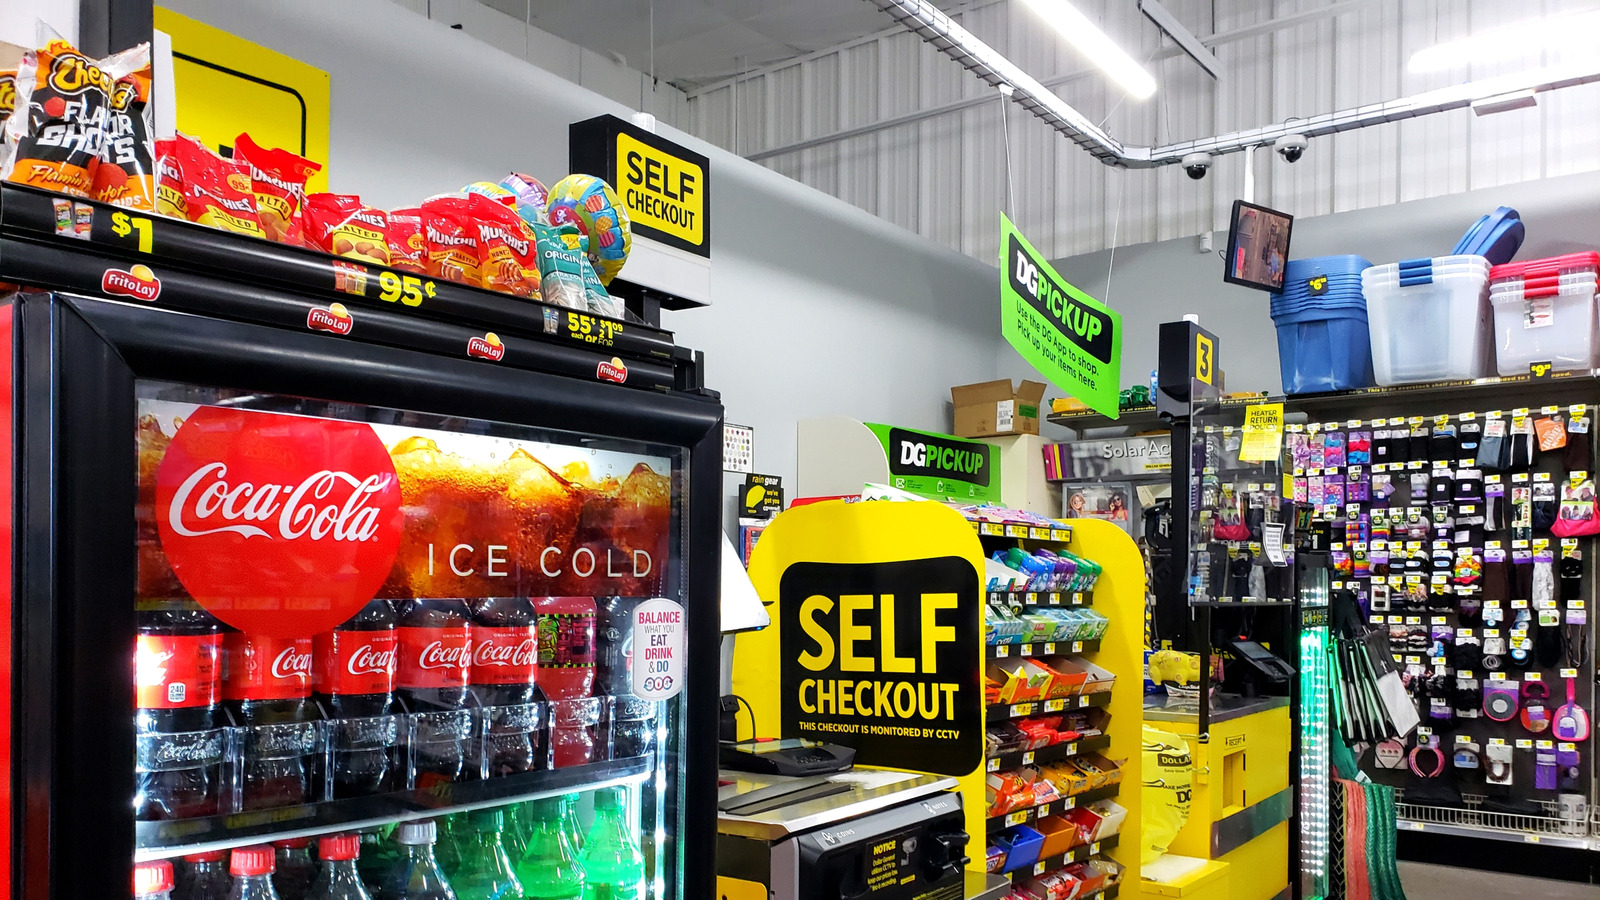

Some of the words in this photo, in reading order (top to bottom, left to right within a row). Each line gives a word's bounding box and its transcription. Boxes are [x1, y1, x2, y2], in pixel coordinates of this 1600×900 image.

[626, 151, 695, 203] SELF
[258, 196, 289, 214] ALTED
[626, 188, 695, 230] CHECKOUT
[111, 211, 153, 253] $1
[379, 271, 437, 307] 95¢
[567, 312, 596, 335] 55¢
[1016, 300, 1028, 321] Use
[1030, 314, 1040, 332] the
[1042, 325, 1052, 343] DG
[1053, 337, 1067, 356] App
[1068, 349, 1076, 362] to
[1078, 356, 1099, 376] shop.
[1017, 319, 1031, 342] Pick
[1031, 335, 1041, 350] up
[1042, 345, 1056, 364] your
[1057, 356, 1077, 379] items
[1078, 370, 1097, 391] here.
[1200, 341, 1209, 378] 3
[1250, 416, 1278, 424] RETURN
[752, 475, 764, 484] rain
[764, 477, 778, 486] gear
[169, 462, 391, 542] Coca-Cola
[428, 543, 508, 577] ICE
[539, 546, 652, 578] COLD
[638, 611, 680, 625] BALANCE
[644, 625, 661, 634] WHAT
[662, 624, 675, 634] YOU
[797, 592, 958, 674] SELF
[650, 634, 668, 647] EAT
[645, 647, 673, 660] DRINK
[648, 661, 655, 673] &
[656, 660, 669, 673] DO
[170, 685, 184, 694] 240
[798, 679, 960, 721] CHECKOUT
[799, 721, 817, 731] THIS
[817, 723, 859, 734] CHECKOUT
[861, 725, 869, 734] IS
[870, 726, 921, 738] MONITORED
[922, 729, 934, 738] BY
[935, 730, 960, 740] CCTV
[1161, 756, 1191, 764] DOLLA
[836, 828, 855, 839] COINS
[873, 840, 896, 855] NOTICE
